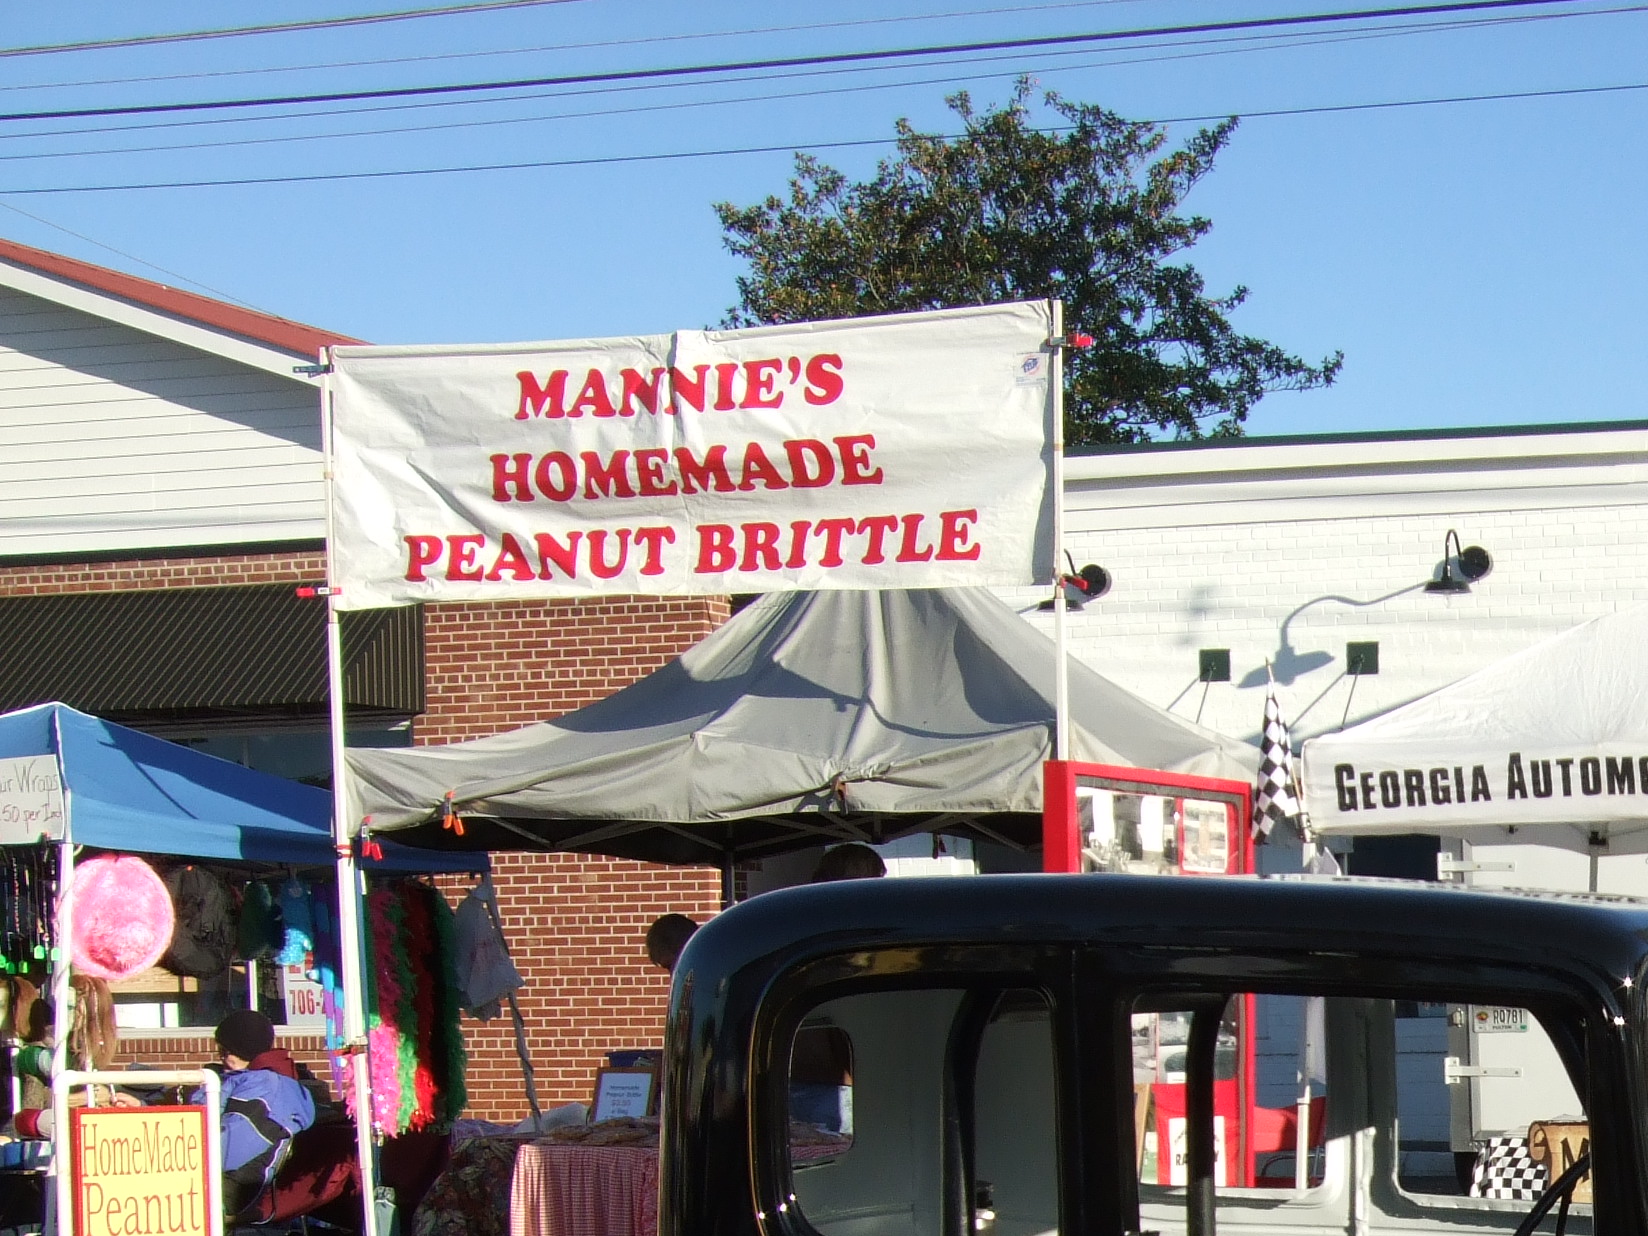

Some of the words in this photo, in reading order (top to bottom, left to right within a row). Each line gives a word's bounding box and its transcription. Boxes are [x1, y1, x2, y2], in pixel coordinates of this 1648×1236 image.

[515, 353, 844, 421] MANNIE'S
[490, 434, 884, 503] HOMEMADE
[404, 526, 677, 583] PEANUT
[694, 508, 982, 574] BRITTLE
[1334, 763, 1491, 812] GEORGIA
[81, 1117, 198, 1177] HomeMade
